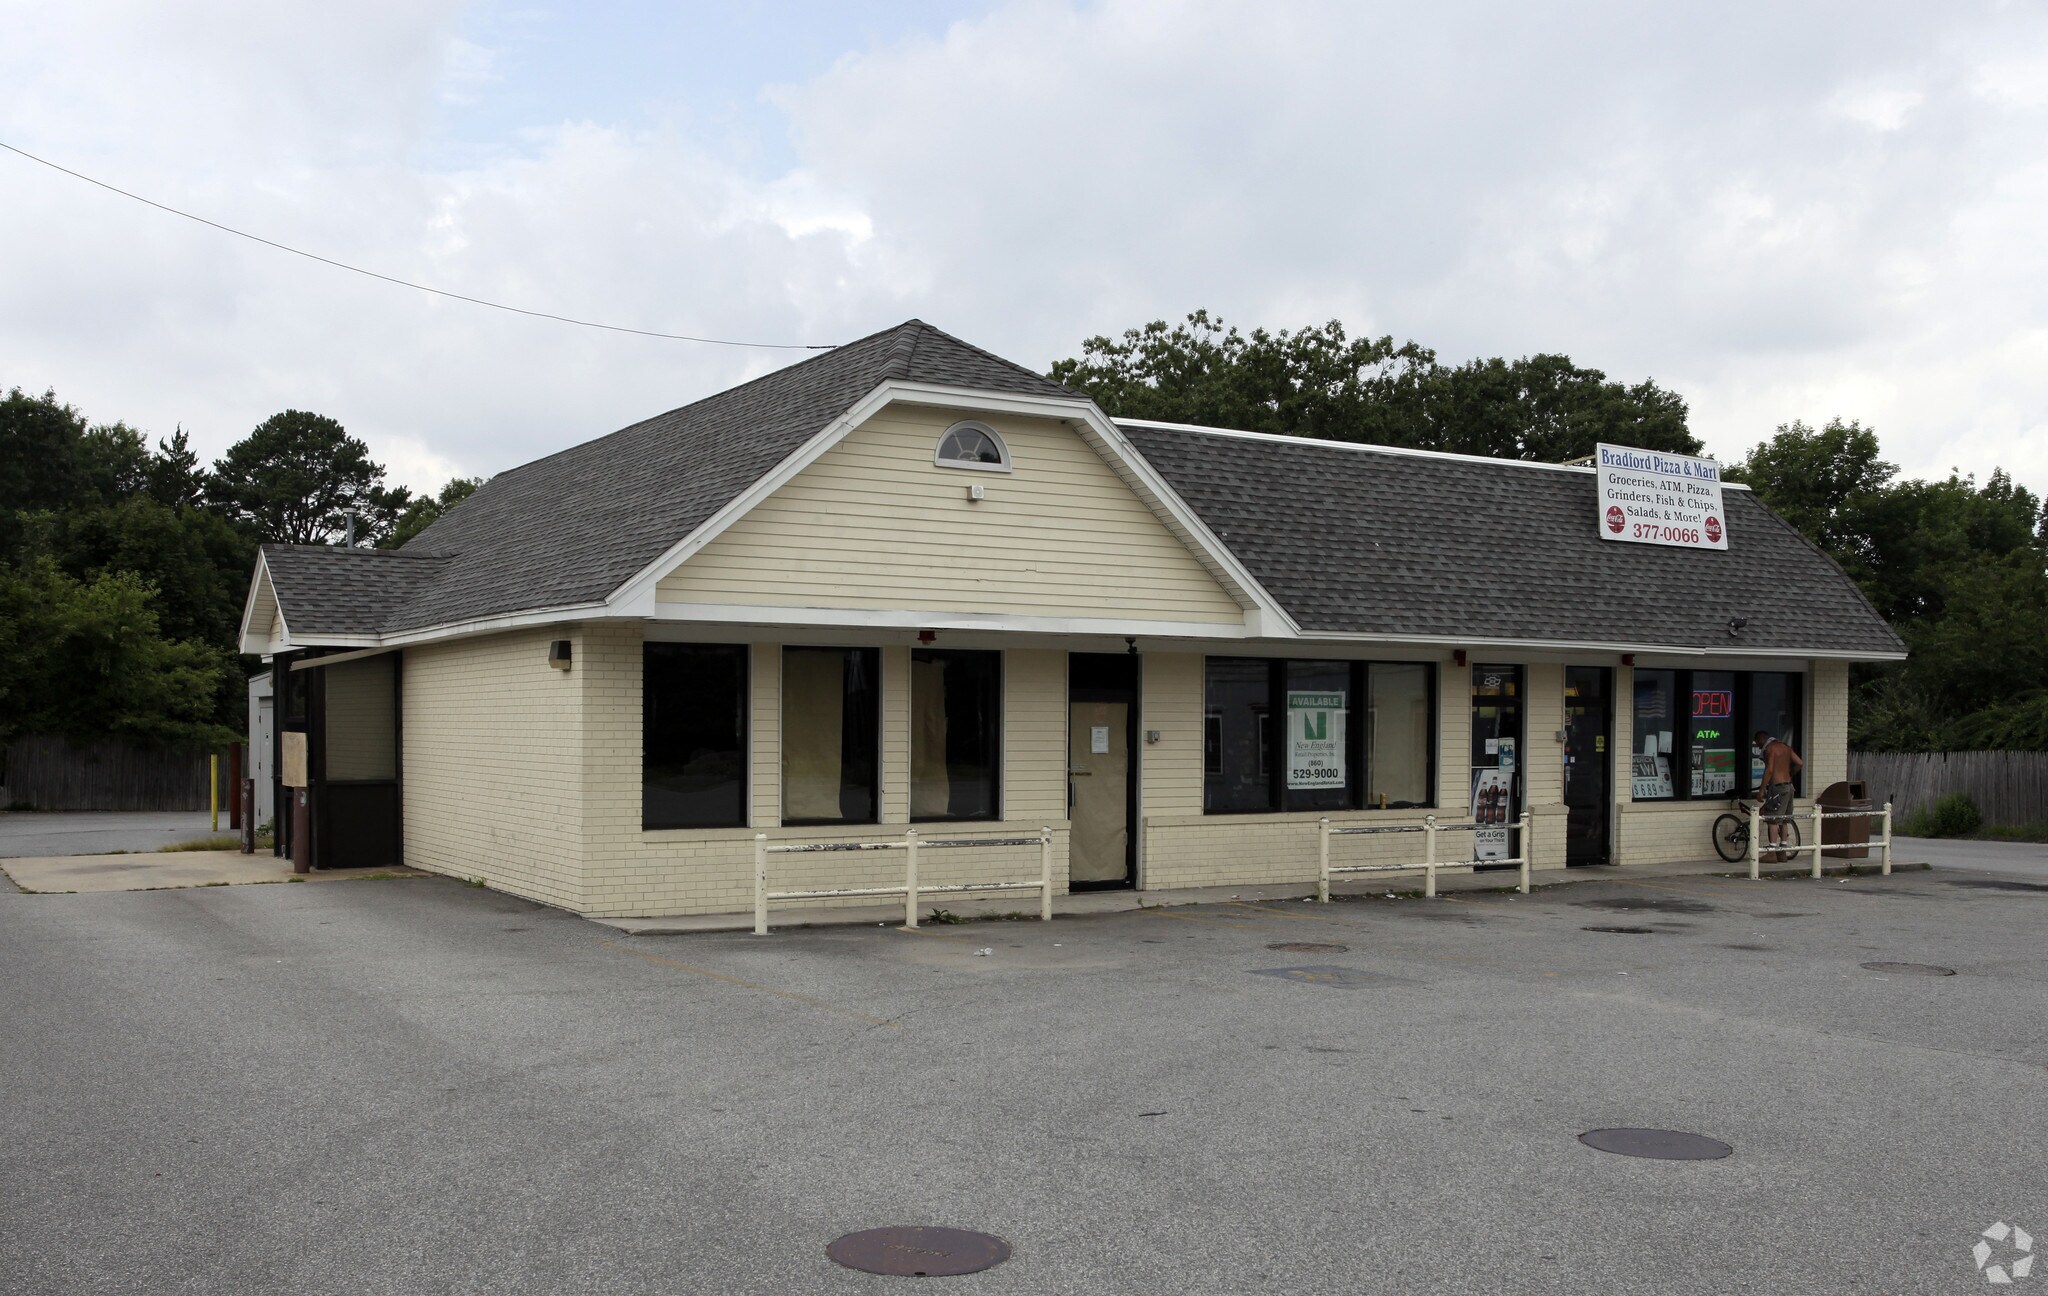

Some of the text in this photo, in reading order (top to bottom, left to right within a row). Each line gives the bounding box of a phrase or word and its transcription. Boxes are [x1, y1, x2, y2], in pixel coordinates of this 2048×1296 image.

[1601, 449, 1716, 479] Bradford Pizza & Mart
[1609, 473, 1713, 497] Groceries, ATM, Pizza,
[1608, 489, 1718, 512] Grinders, Fish & Chips,
[1627, 506, 1701, 523] Salads, & More!
[1633, 524, 1699, 543] 377-0066
[1292, 698, 1338, 706] AVAILABLE
[1693, 693, 1730, 715] OPEN
[1293, 768, 1338, 779] 529-9000
